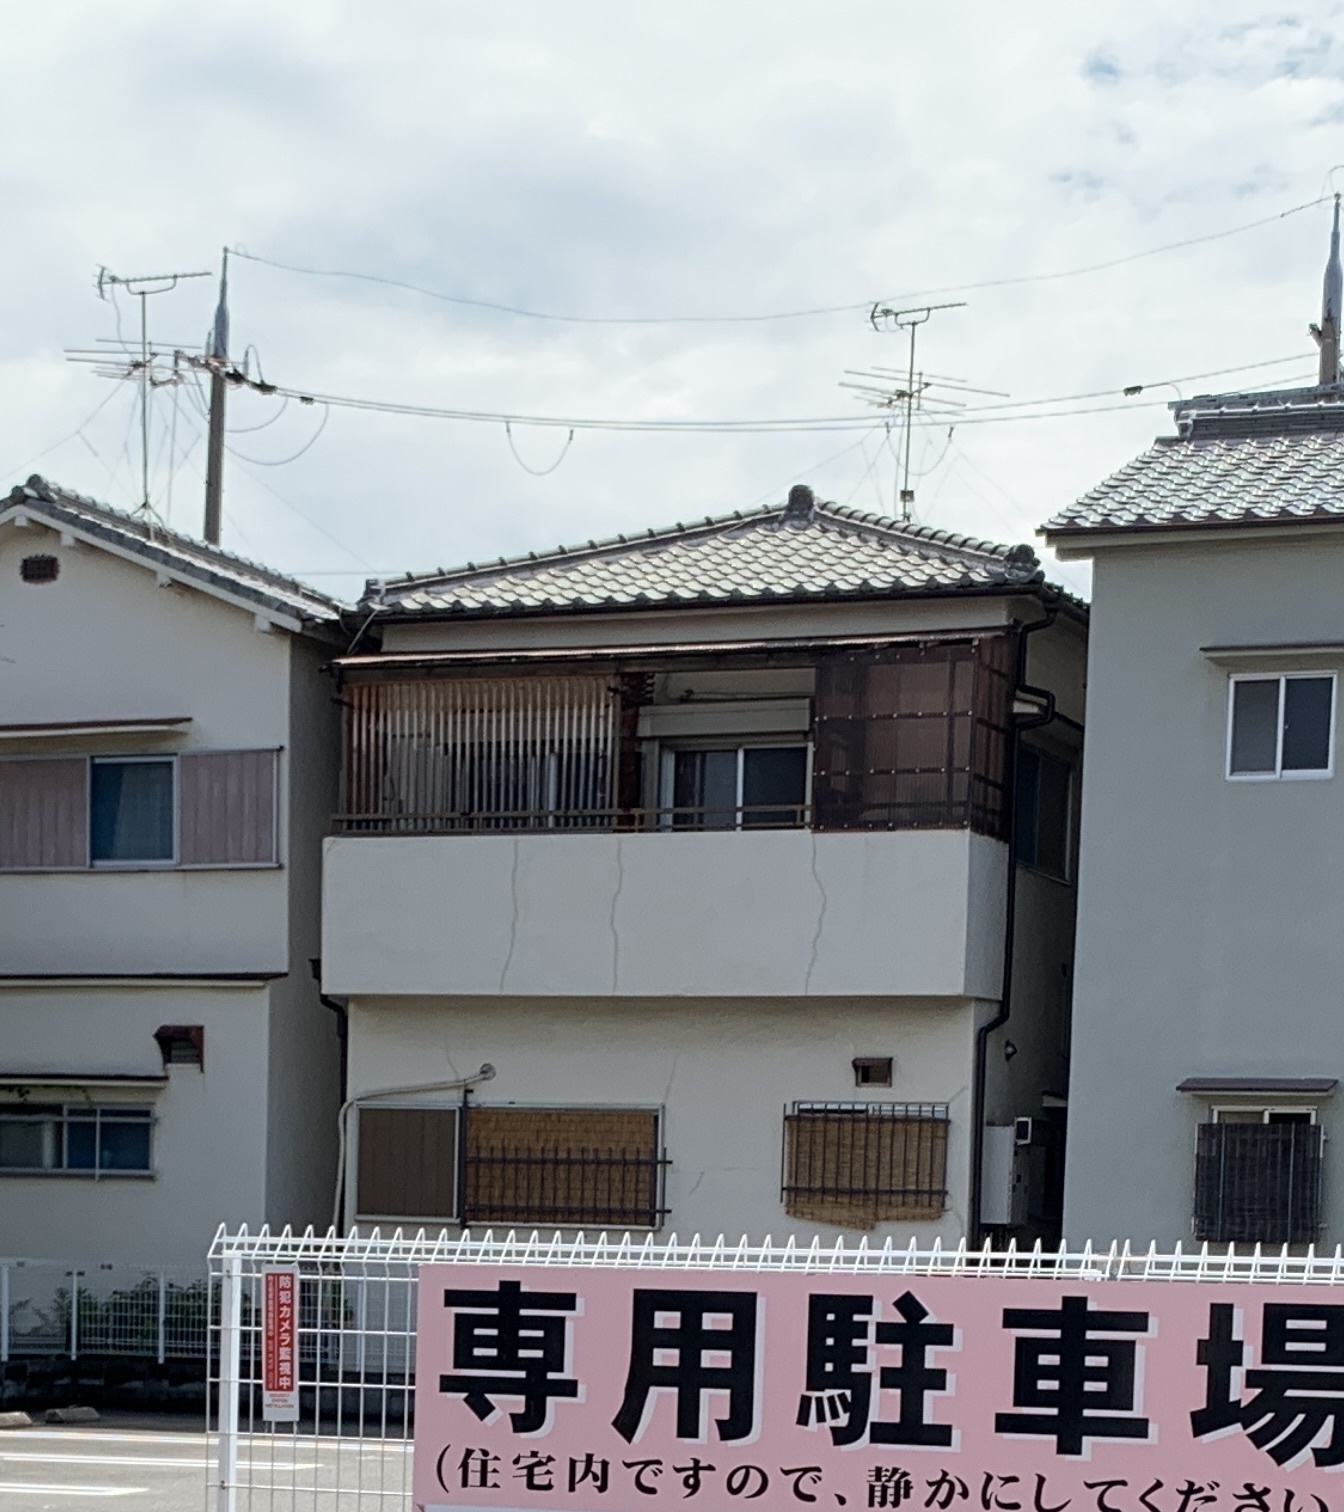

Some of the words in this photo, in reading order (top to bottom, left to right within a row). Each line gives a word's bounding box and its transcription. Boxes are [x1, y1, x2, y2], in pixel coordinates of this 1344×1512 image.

[278, 1275, 292, 1390] 防犯カメラ監視中
